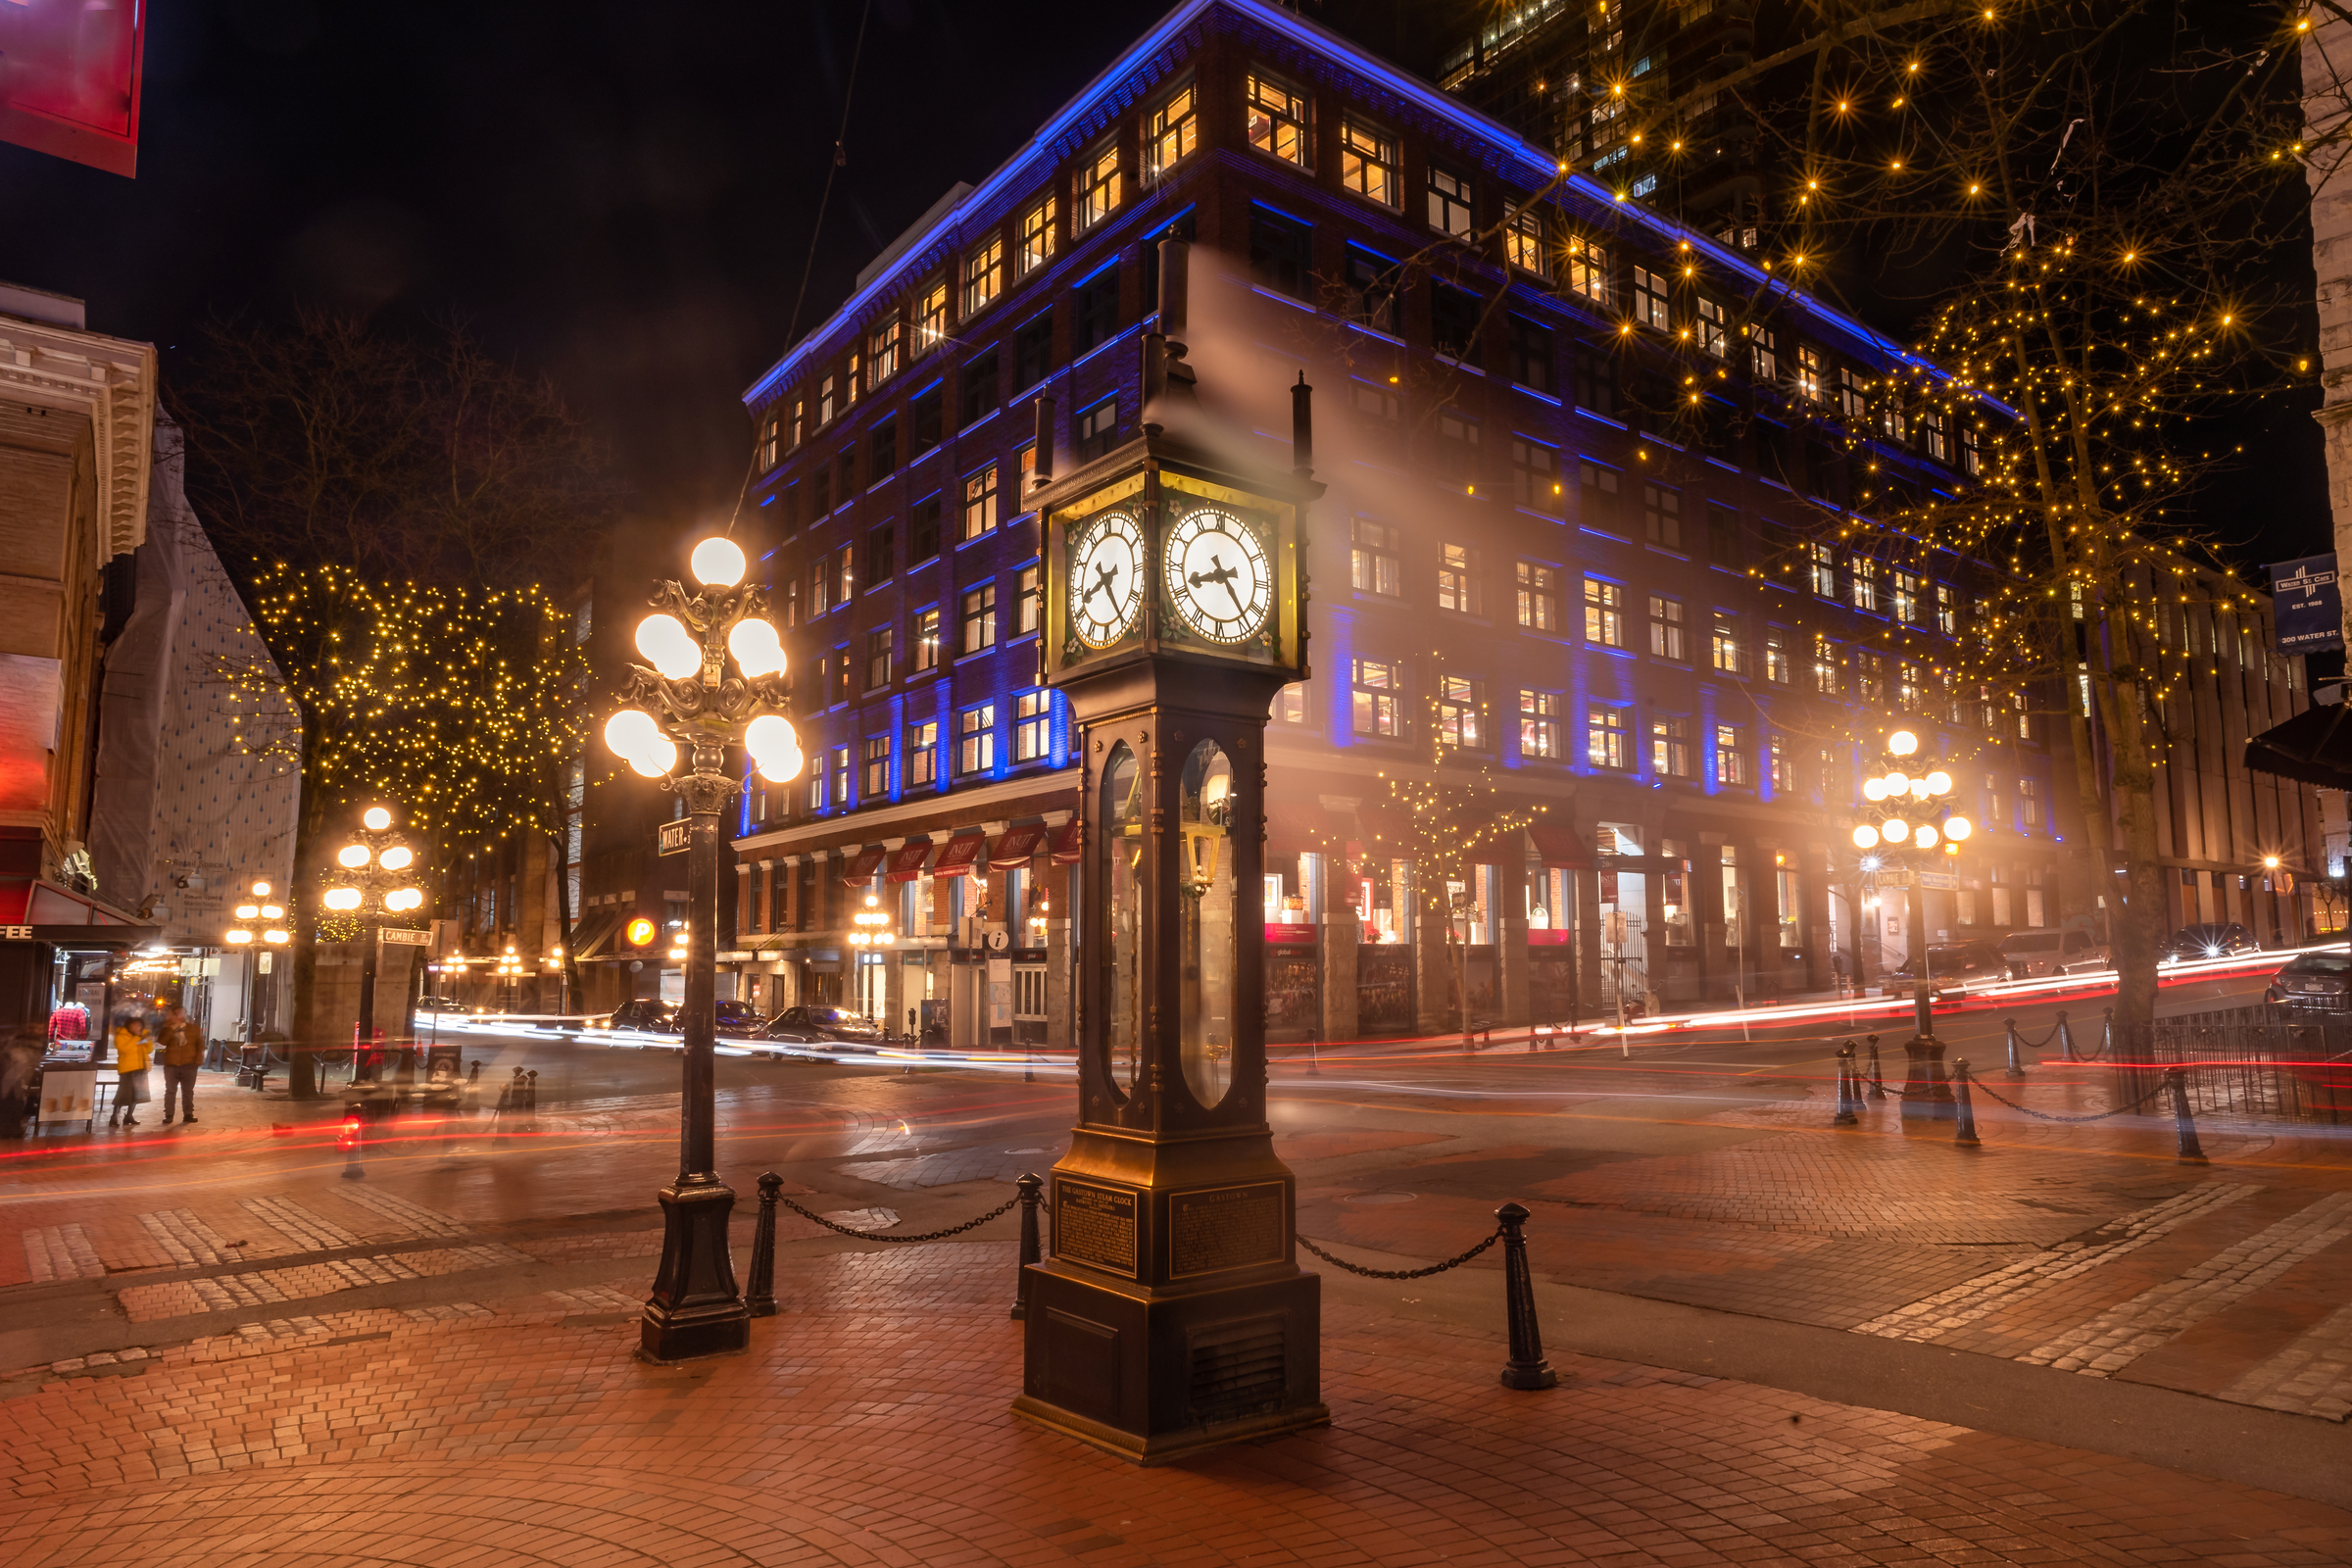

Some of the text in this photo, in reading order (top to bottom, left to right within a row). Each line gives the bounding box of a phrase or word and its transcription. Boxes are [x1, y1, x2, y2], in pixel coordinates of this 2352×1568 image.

[1192, 516, 1204, 532] XI
[1216, 515, 1225, 531] XII
[1176, 533, 1189, 548] X
[1170, 561, 1183, 571] IX
[1255, 580, 1267, 589] III
[1175, 585, 1189, 604] VIII
[1192, 608, 1203, 626] VII
[1250, 602, 1263, 617] IIII
[1216, 621, 1225, 637] VI
[1238, 619, 1249, 634] V
[2297, 631, 2326, 641] WATER
[662, 827, 684, 849] WATER
[385, 931, 416, 942] CAMBIE
[633, 922, 650, 941] P
[1072, 1187, 1095, 1199] GASTOWN
[1097, 1192, 1112, 1201] STEAM
[1113, 1196, 1132, 1206] CLOCK
[1209, 1192, 1249, 1202] GASTOWN
